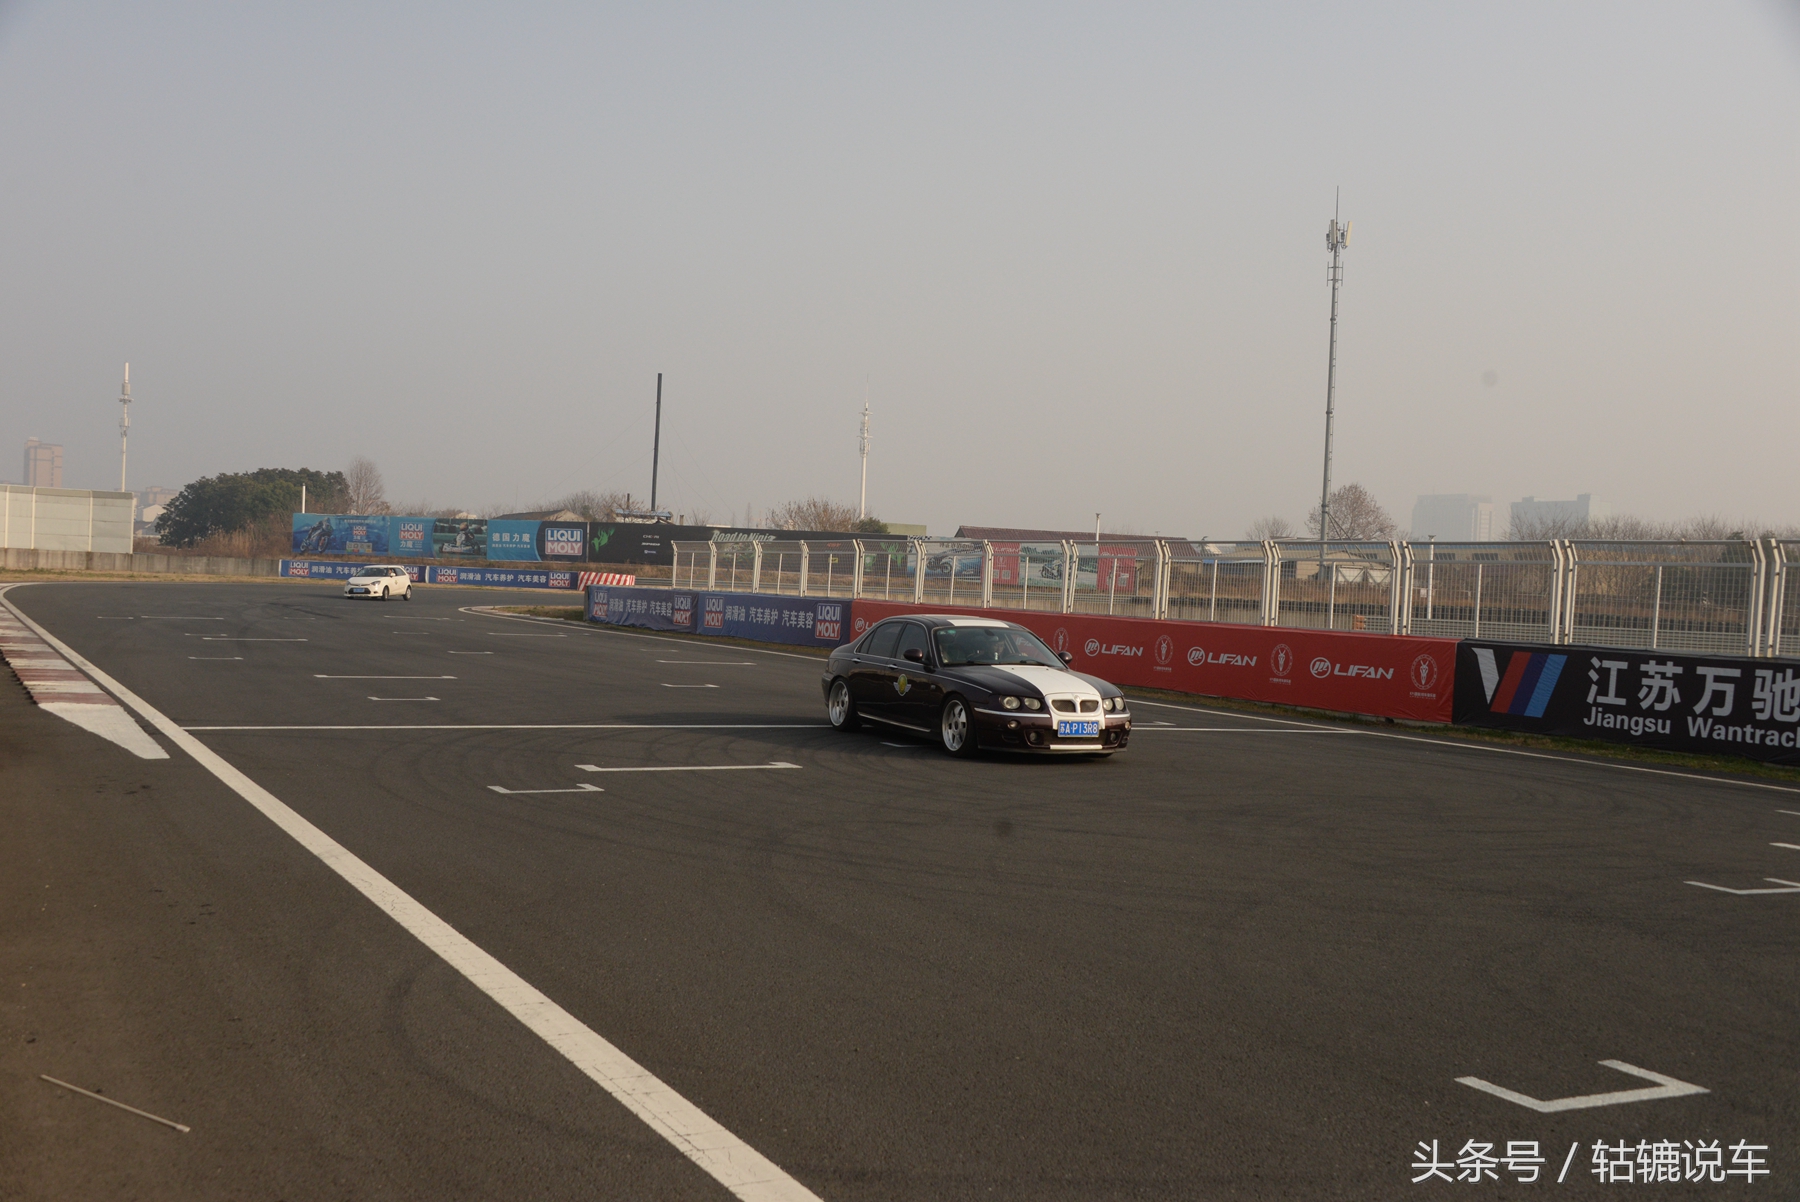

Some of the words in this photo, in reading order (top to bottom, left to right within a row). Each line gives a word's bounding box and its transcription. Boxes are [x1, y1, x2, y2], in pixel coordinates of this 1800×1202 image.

[401, 523, 423, 532] LIQUI
[547, 529, 581, 541] LIQUI
[547, 542, 581, 554] MOLY
[289, 568, 309, 576] MOLY
[290, 561, 309, 569] LIQUI
[311, 565, 333, 574] 润滑油
[460, 572, 482, 581] 润滑油
[485, 573, 515, 582] 汽车养护
[518, 575, 547, 583] 汽车美容
[549, 579, 570, 587] MOLY
[550, 572, 570, 580] LIQUI
[594, 591, 608, 603] LIQUI
[674, 597, 691, 610] LIQUI
[593, 603, 608, 617] MOLY
[609, 598, 624, 612] 润滑油
[626, 599, 648, 613] 汽车养护
[649, 601, 673, 617] 汽车美容
[706, 598, 724, 612] LIQUI
[673, 610, 691, 624] MOLY
[705, 612, 723, 627] MOLY
[725, 605, 746, 622] 润滑油
[749, 607, 779, 626] 汽车养护
[782, 609, 814, 629] 汽车美容
[817, 605, 840, 621] LIQUI
[816, 621, 840, 638] MOLY
[1101, 643, 1144, 657] LIFAN
[1207, 652, 1258, 667] LIFAN
[1333, 663, 1395, 680] LIFAN
[1586, 656, 1800, 723] 江苏万驰
[1583, 706, 1672, 736] Jiangsu
